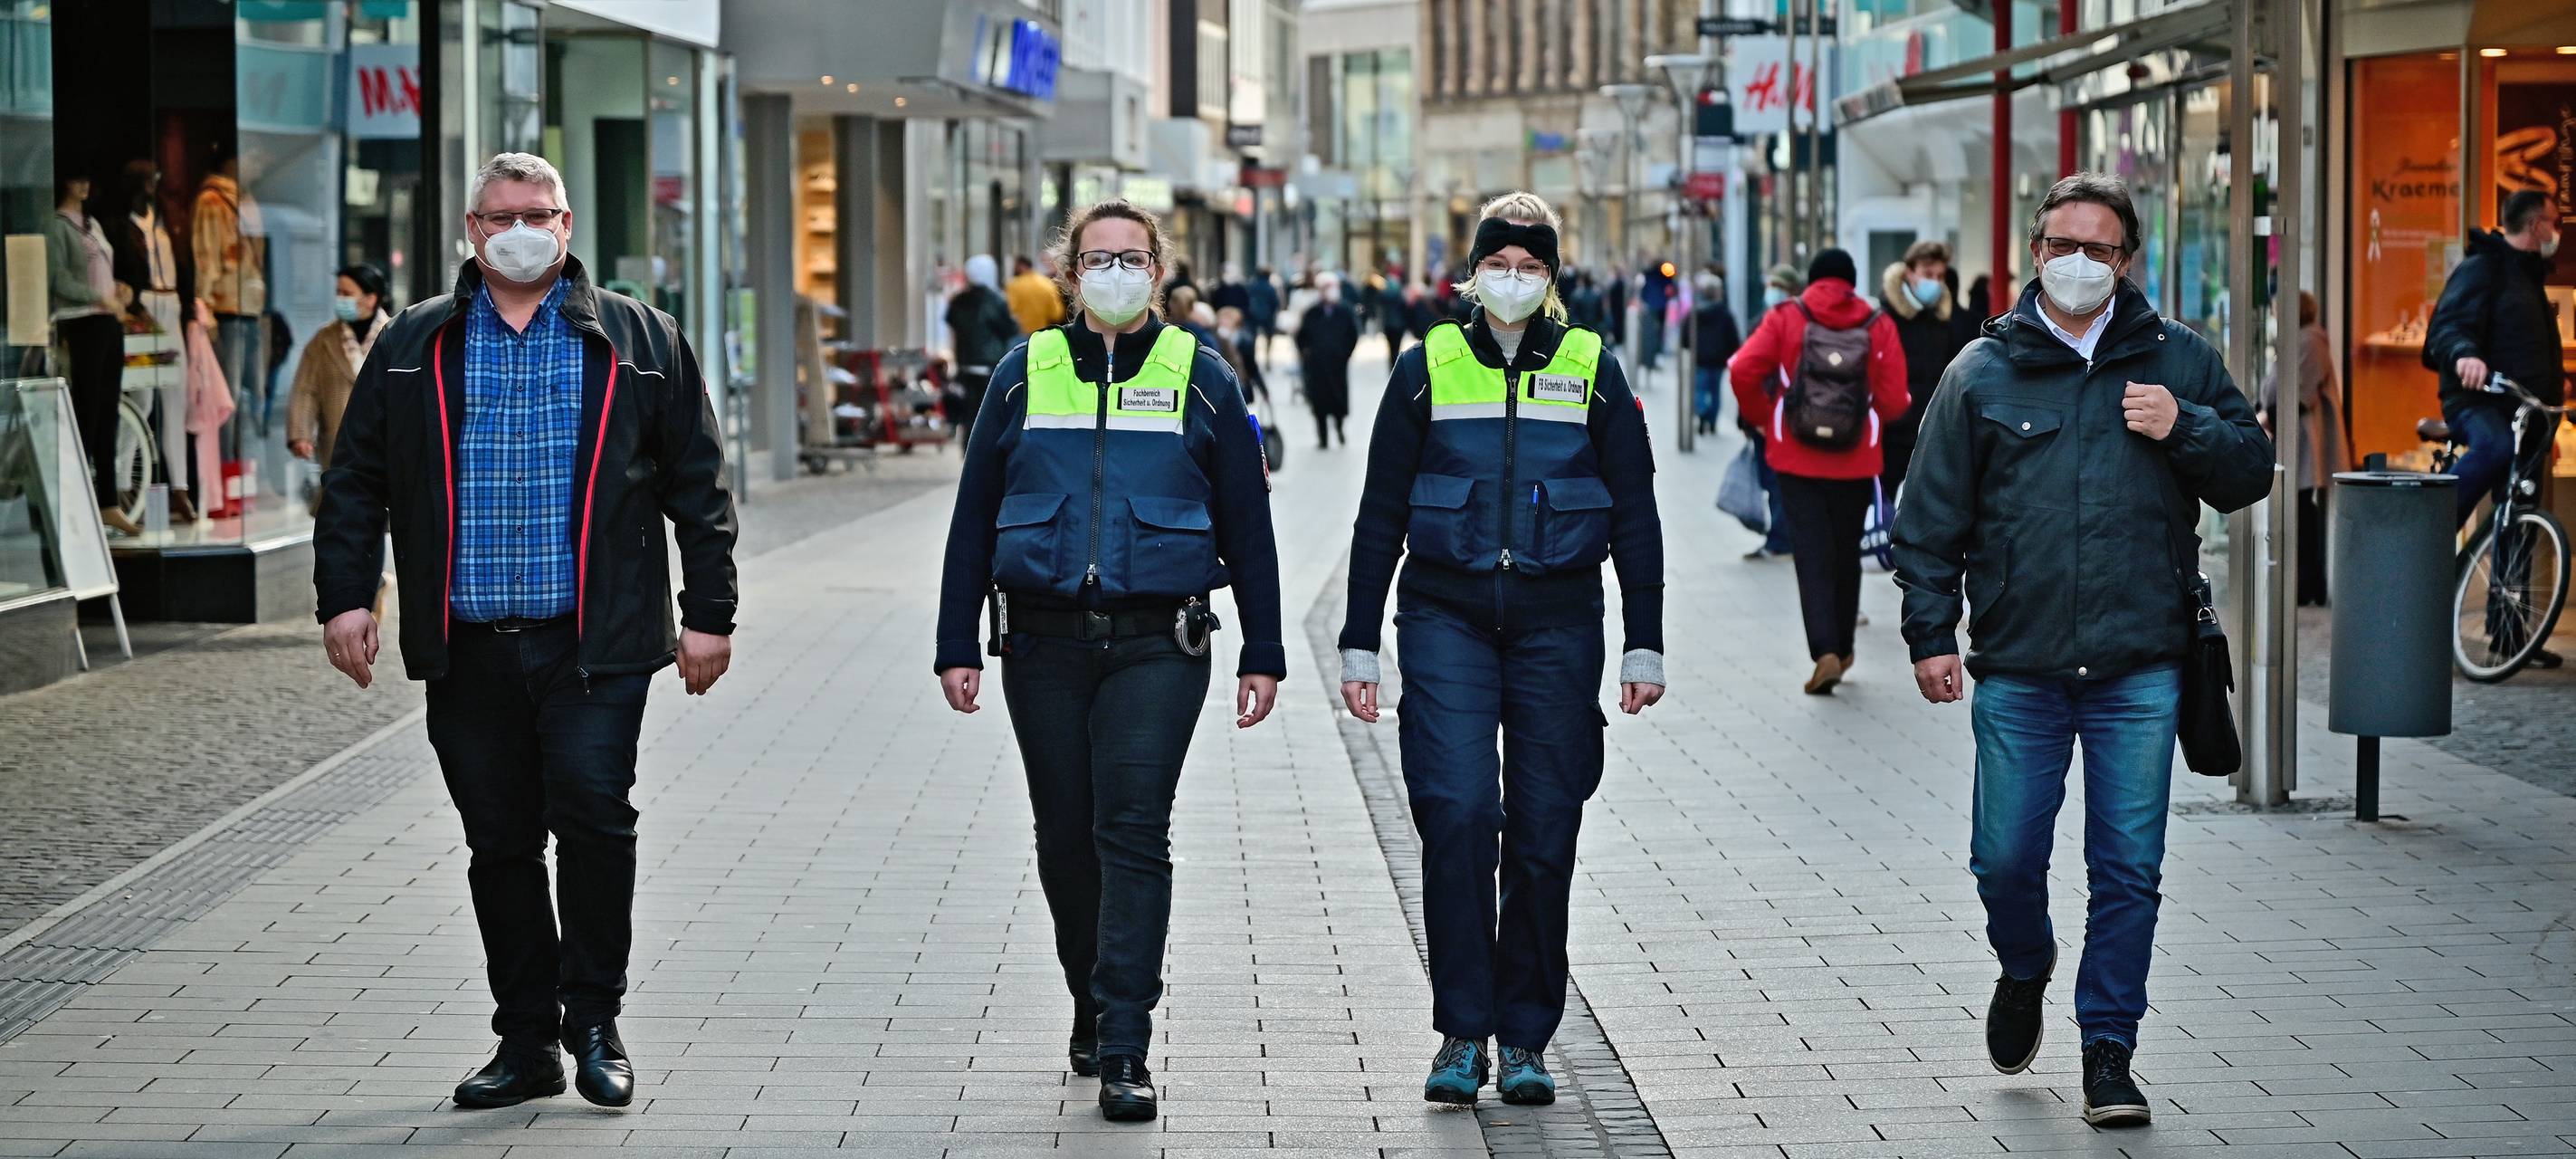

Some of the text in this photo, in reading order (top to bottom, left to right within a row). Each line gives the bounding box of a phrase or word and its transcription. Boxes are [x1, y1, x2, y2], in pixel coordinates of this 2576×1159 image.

[1539, 378, 1544, 390] FB
[1544, 378, 1563, 392] Sicherheit
[1568, 380, 1582, 398] Ordnung
[1151, 399, 1170, 408] Ordnung
